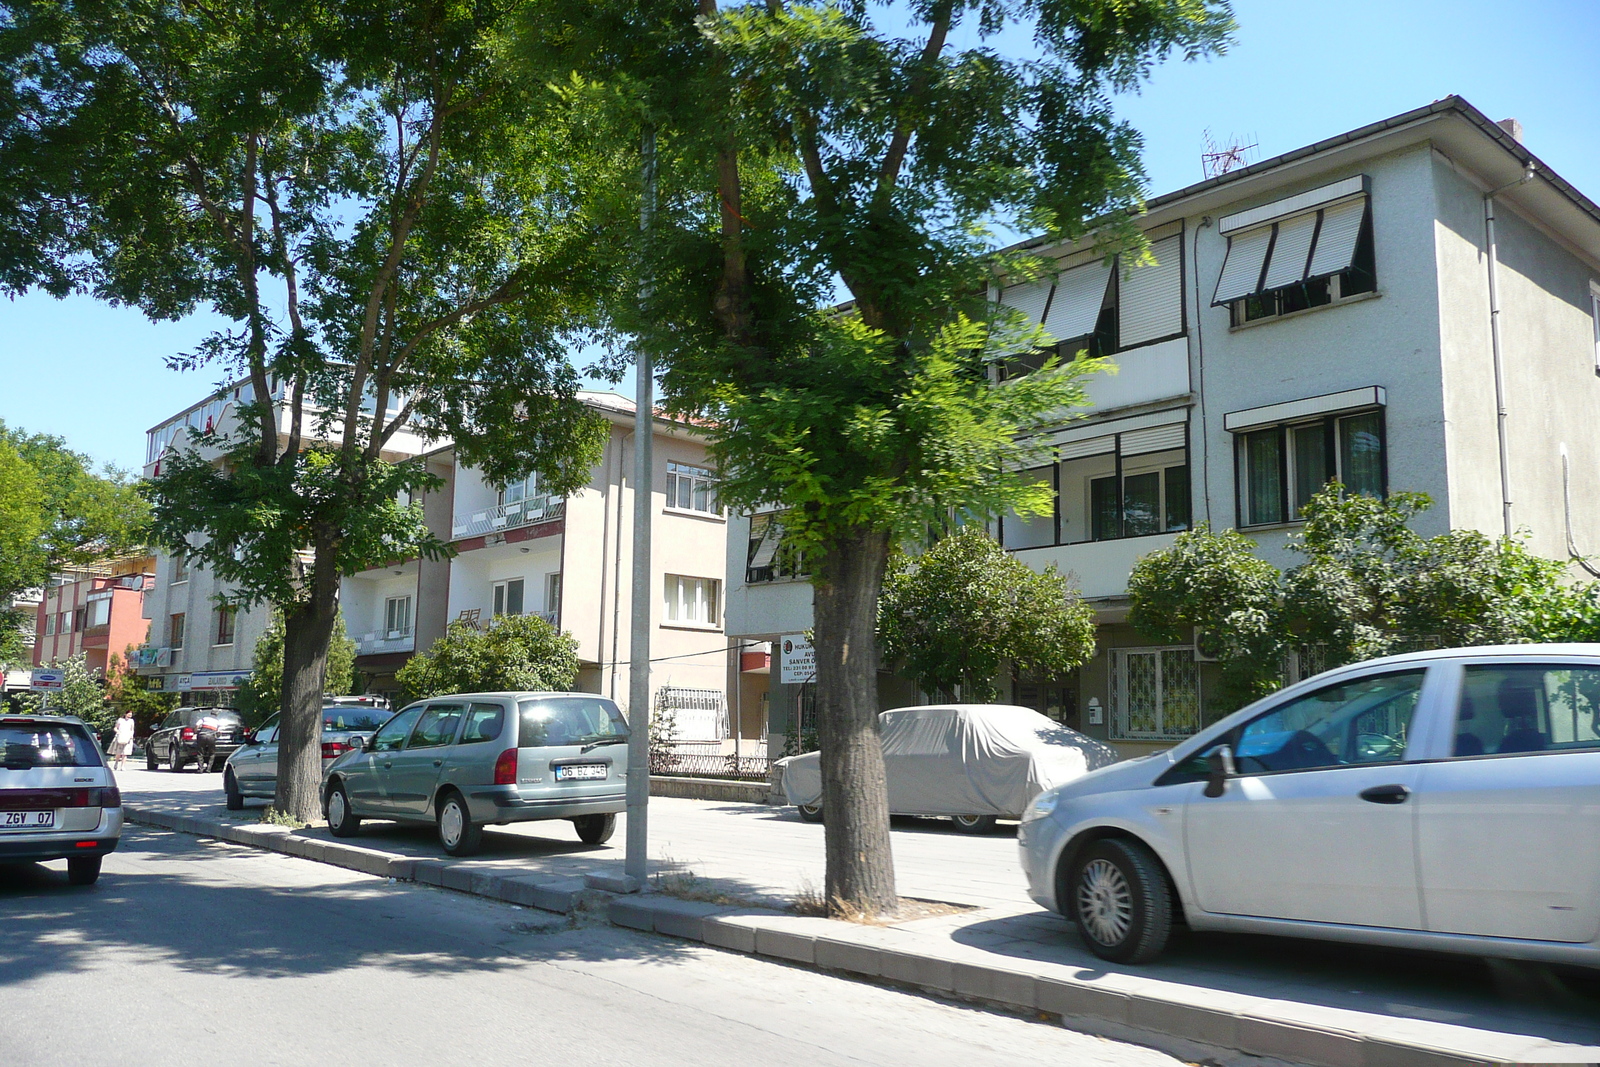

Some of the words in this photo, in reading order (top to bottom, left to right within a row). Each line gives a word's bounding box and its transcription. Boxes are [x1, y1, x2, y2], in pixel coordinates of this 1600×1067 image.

[562, 767, 573, 776] 06
[6, 812, 27, 824] ZGV
[37, 812, 52, 824] 07
